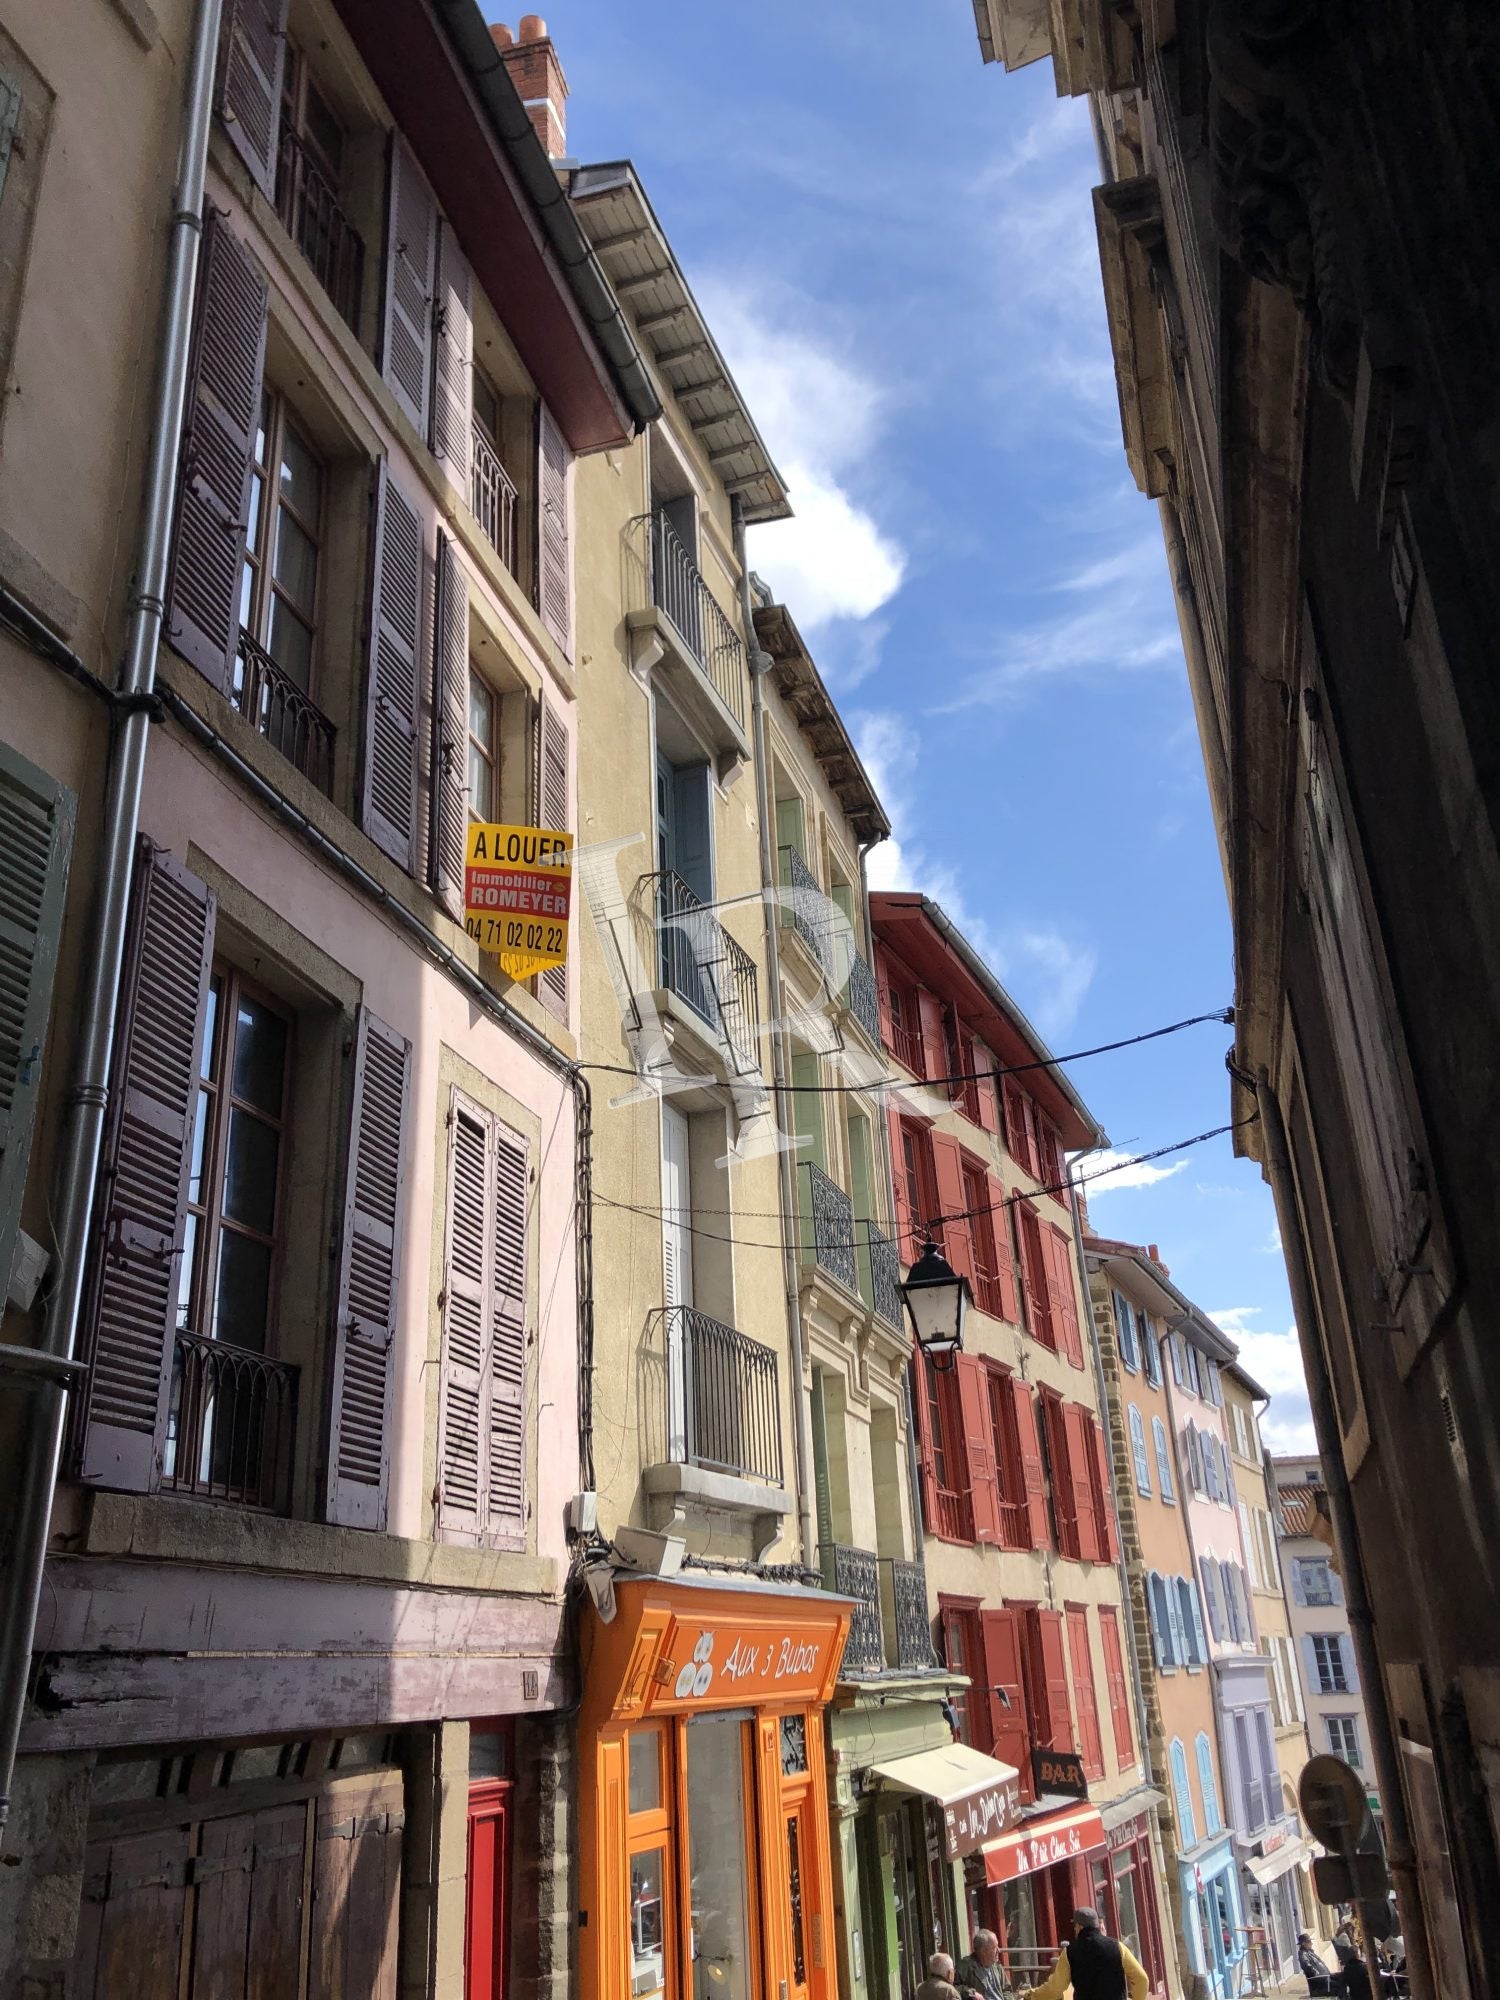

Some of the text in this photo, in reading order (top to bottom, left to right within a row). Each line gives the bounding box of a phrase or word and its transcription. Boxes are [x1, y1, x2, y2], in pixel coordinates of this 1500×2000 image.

[473, 831, 566, 868] A LOUER
[471, 870, 552, 892] Immobilier
[470, 886, 567, 914] ROMEYER
[466, 917, 562, 953] 04 71 02 02 22
[720, 1637, 760, 1682] Aux
[760, 1644, 774, 1677] 3
[1041, 1761, 1082, 1787] BAR
